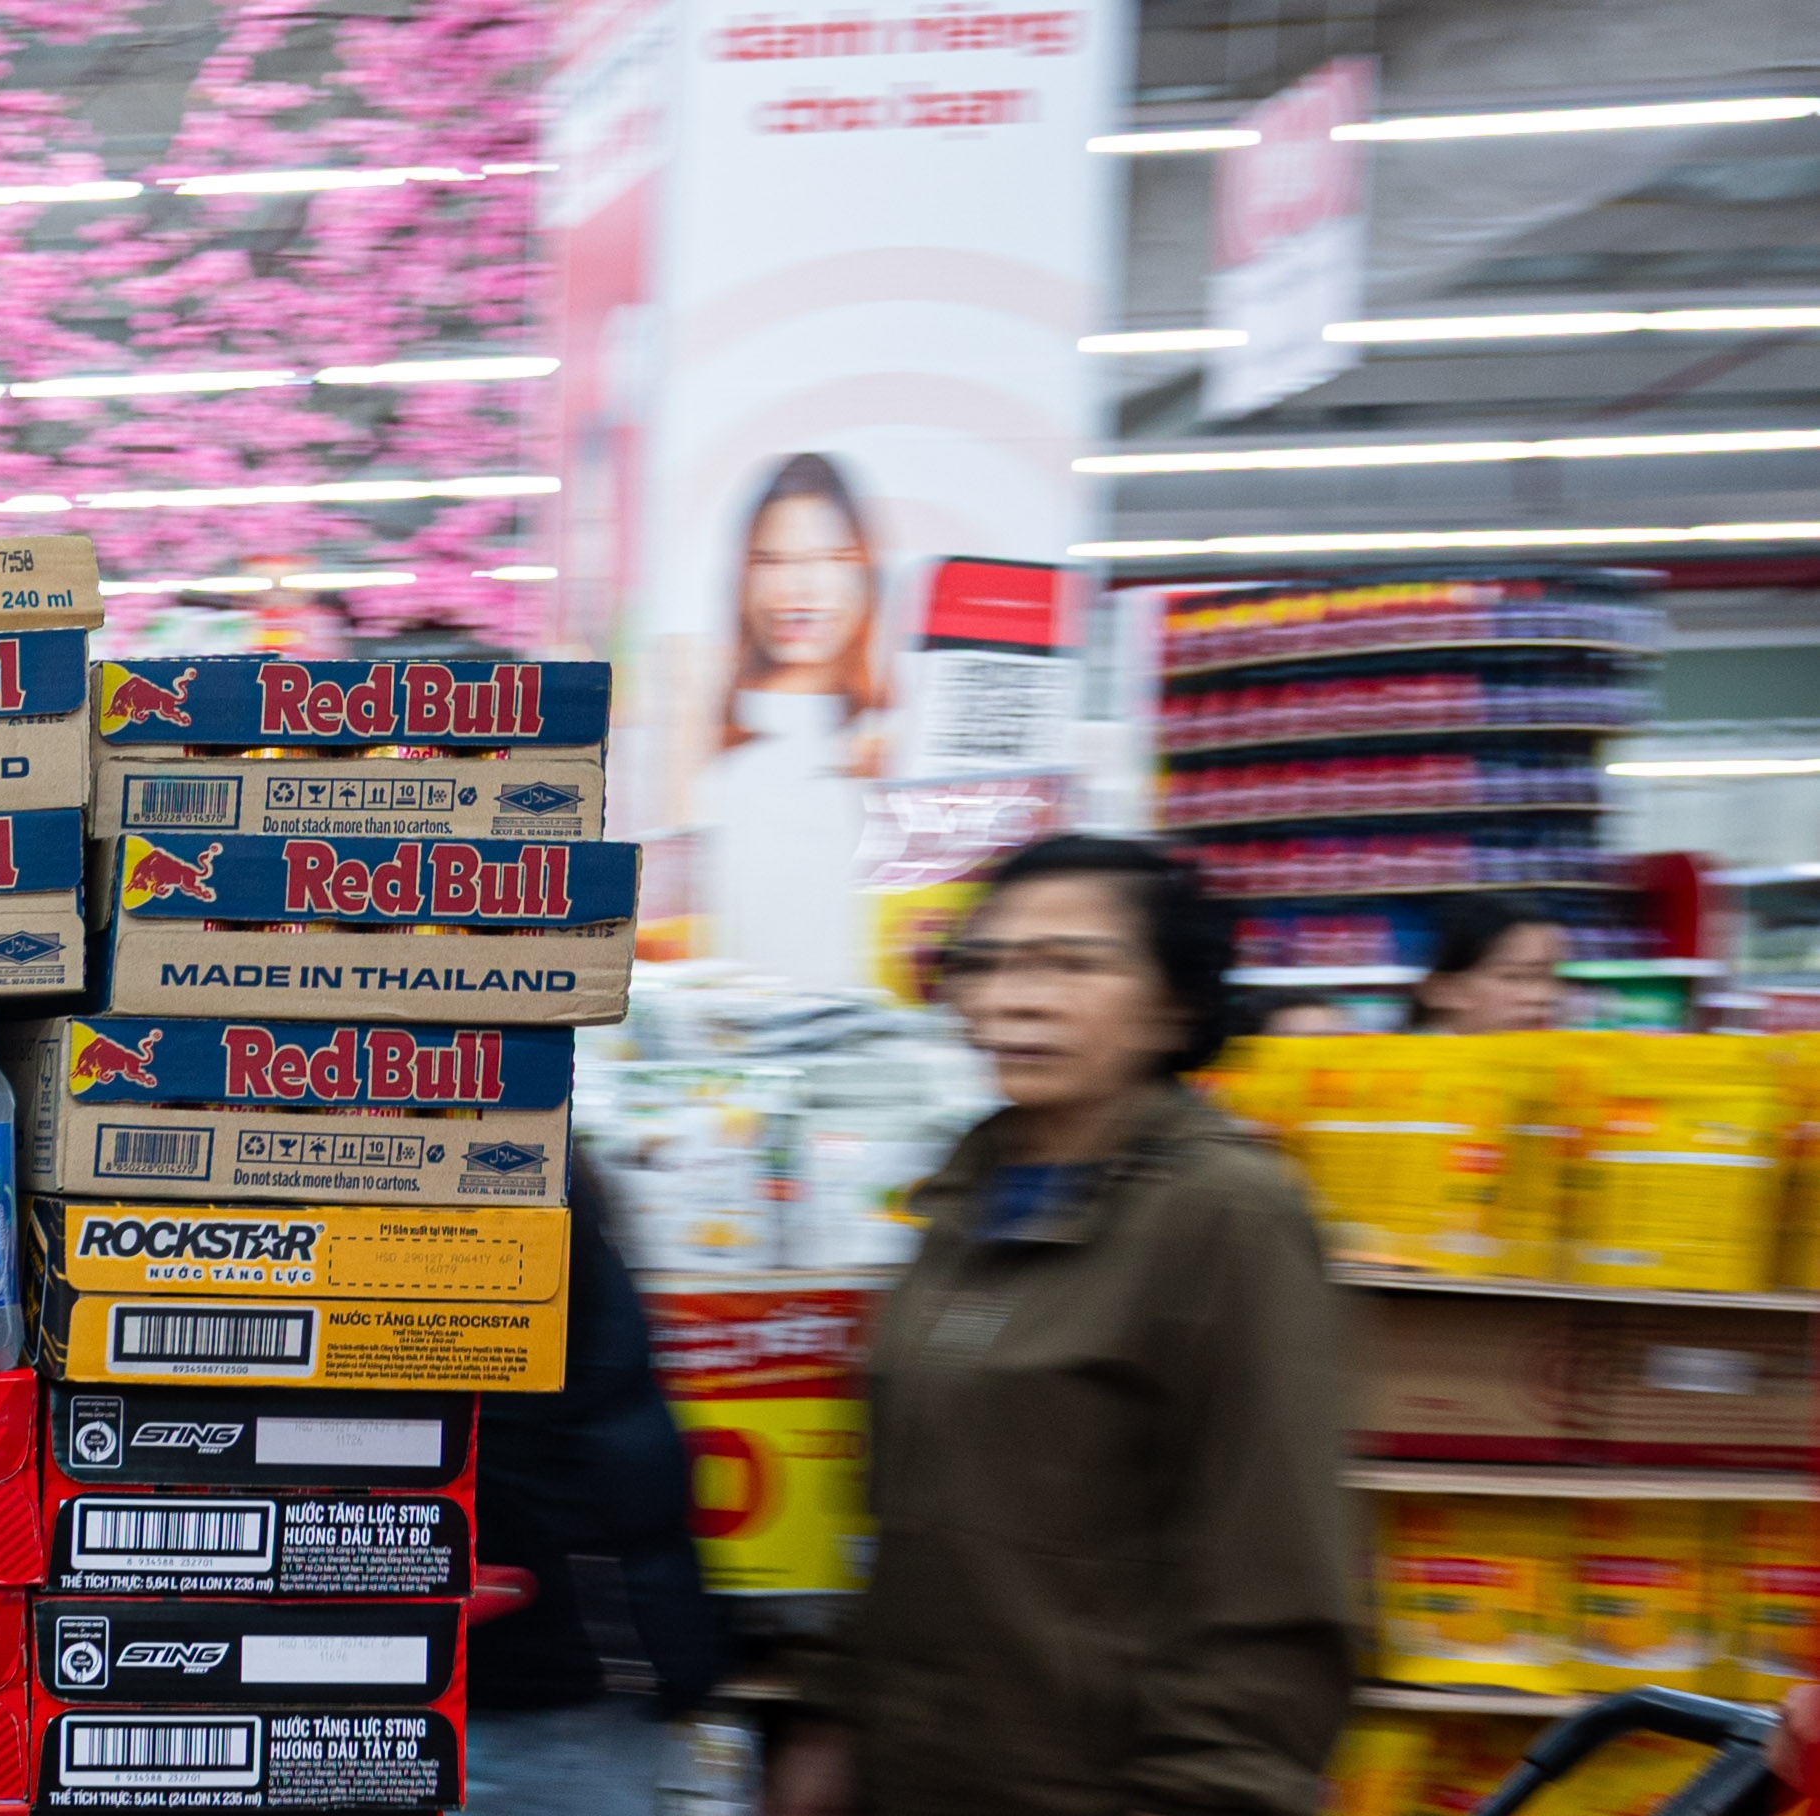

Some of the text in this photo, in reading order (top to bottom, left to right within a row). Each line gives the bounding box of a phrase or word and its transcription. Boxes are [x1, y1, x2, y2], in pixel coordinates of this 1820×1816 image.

[2, 591, 40, 610] 240
[46, 590, 73, 608] ml
[257, 662, 544, 737] Red Bull
[282, 839, 573, 917] Red Bull
[80, 1219, 318, 1262] ROCKSTAR
[329, 1311, 530, 1328] NƯỚC TĂNG LỰC ROCKSTAR
[130, 1422, 244, 1447] STING
[285, 1503, 440, 1525] NƯỚC TĂNG LỰC STING
[283, 1525, 430, 1545] HƯƠNG DÂU TÂY ĐỎ
[85, 1574, 110, 1590] TÍCH
[145, 1577, 169, 1591] 5,64
[180, 1577, 198, 1593] (24
[199, 1577, 221, 1591] LON
[223, 1578, 232, 1591] X
[234, 1578, 254, 1591] 235
